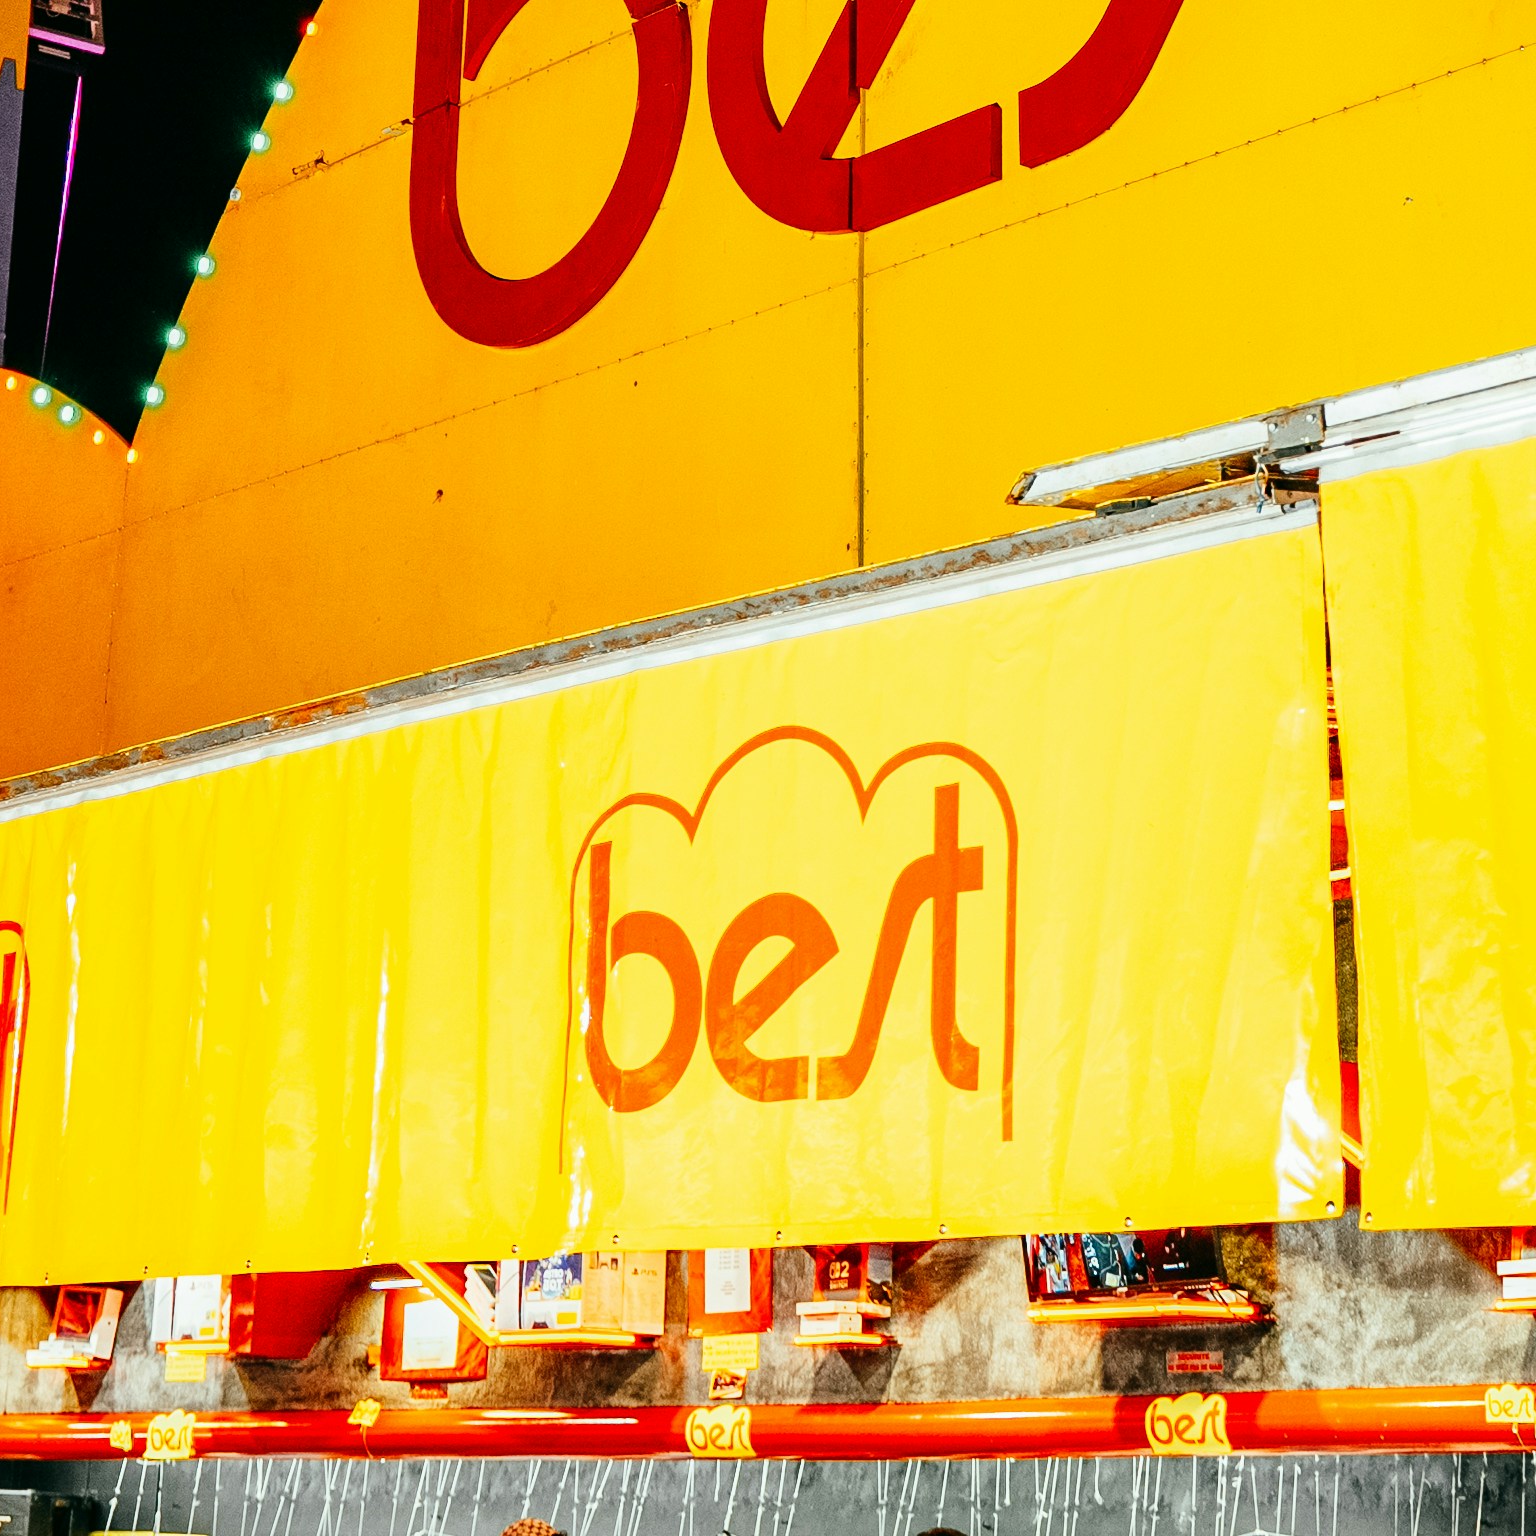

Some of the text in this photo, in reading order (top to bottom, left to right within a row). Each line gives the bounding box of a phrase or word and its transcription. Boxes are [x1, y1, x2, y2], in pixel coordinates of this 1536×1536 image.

[585, 782, 984, 1113] best
[1150, 1400, 1225, 1445] best
[1488, 1392, 1532, 1418] best
[690, 1411, 750, 1451] best
